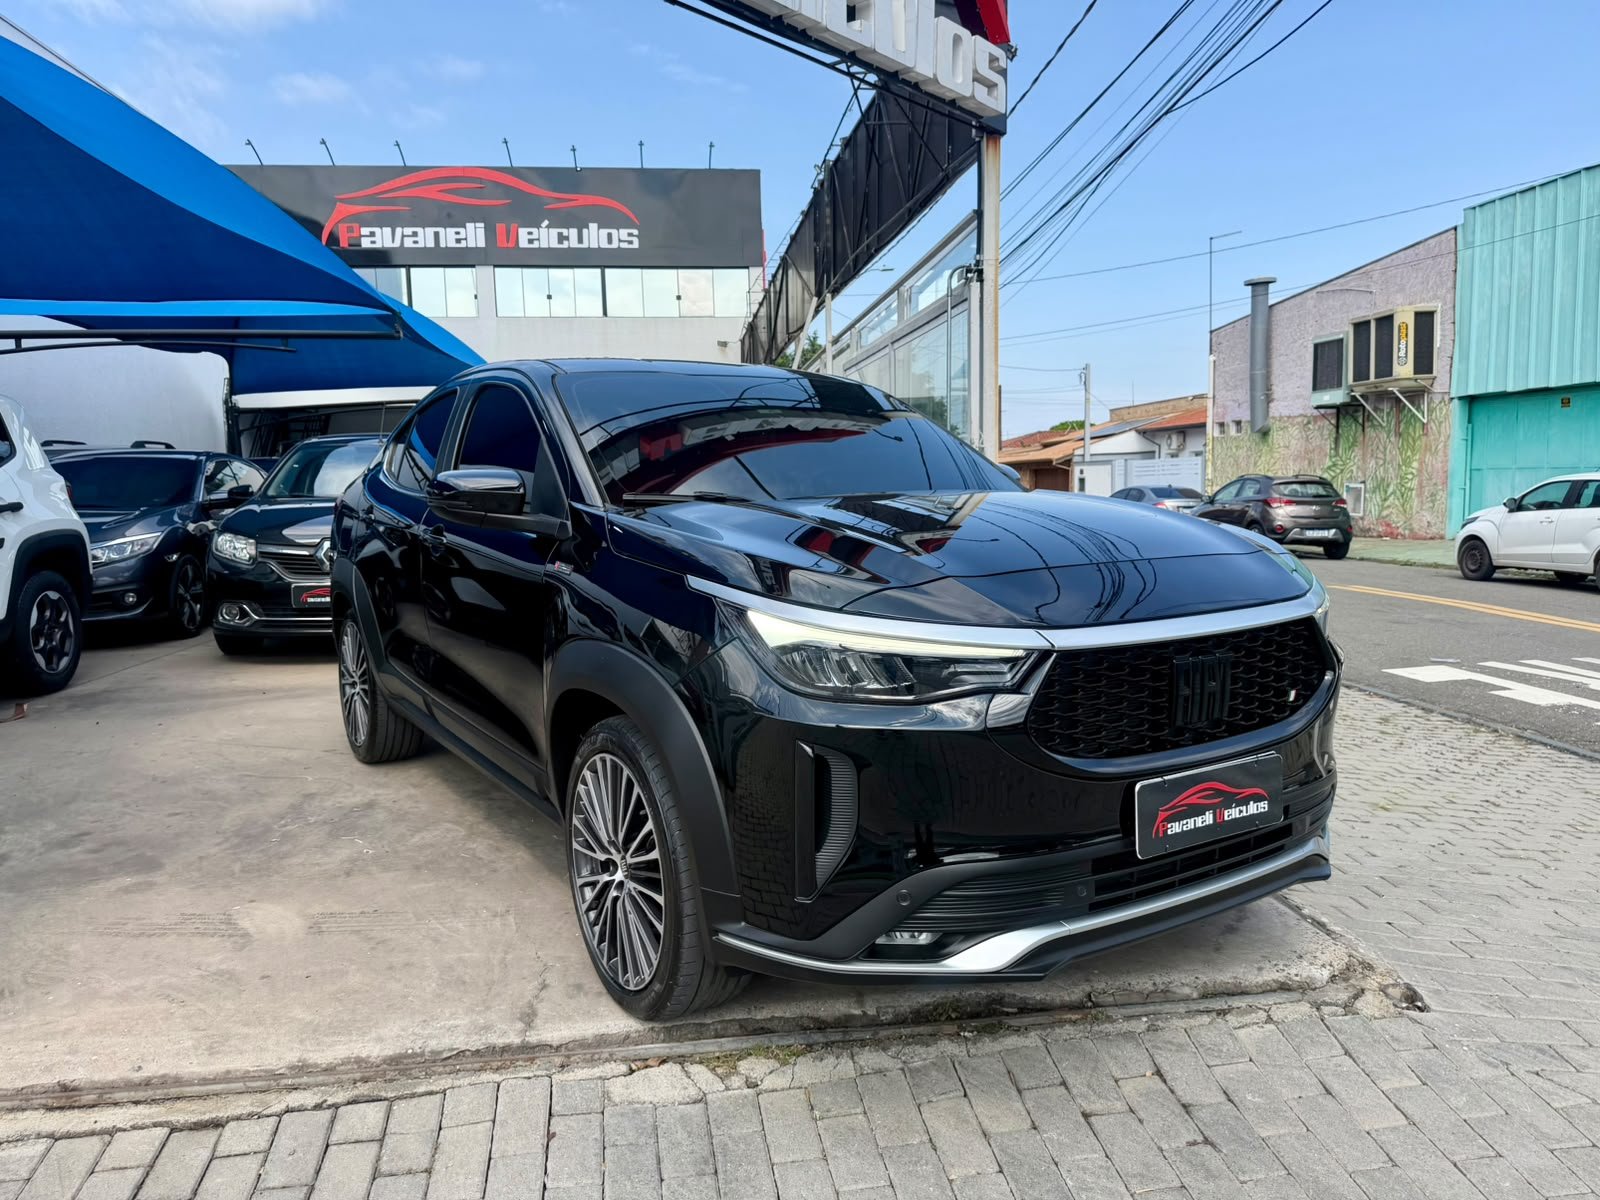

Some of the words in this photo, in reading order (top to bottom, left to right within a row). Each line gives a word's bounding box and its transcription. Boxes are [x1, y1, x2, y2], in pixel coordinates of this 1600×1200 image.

[338, 223, 485, 248] Pavaneli
[496, 219, 640, 249] Veículos
[1159, 810, 1214, 838] Pavaneli
[1216, 801, 1269, 823] Veículos
